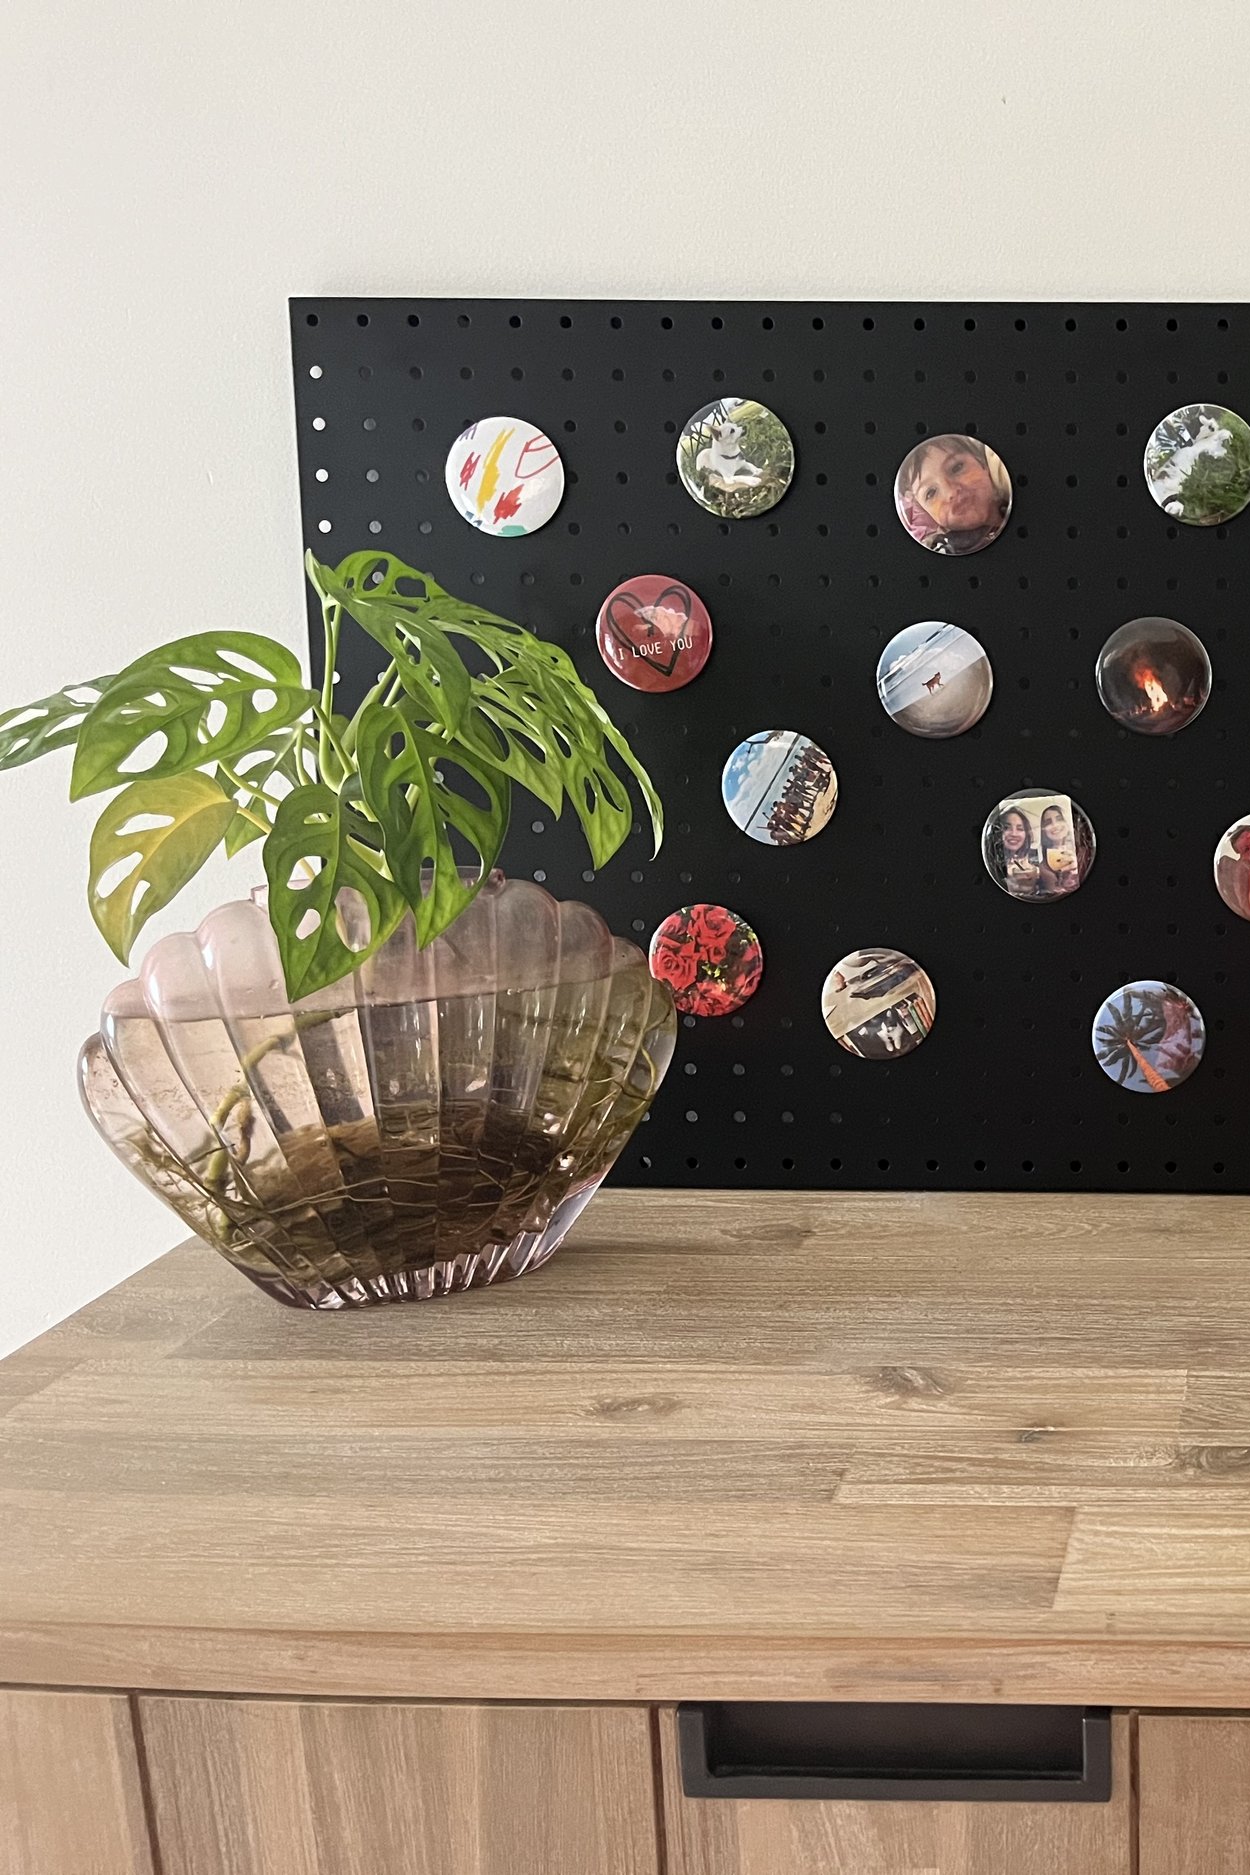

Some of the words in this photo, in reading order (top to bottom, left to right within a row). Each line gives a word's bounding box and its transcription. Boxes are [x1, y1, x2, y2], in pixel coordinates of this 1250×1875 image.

[618, 648, 624, 661] I
[631, 641, 663, 658] LOVE
[670, 636, 693, 651] YOU
